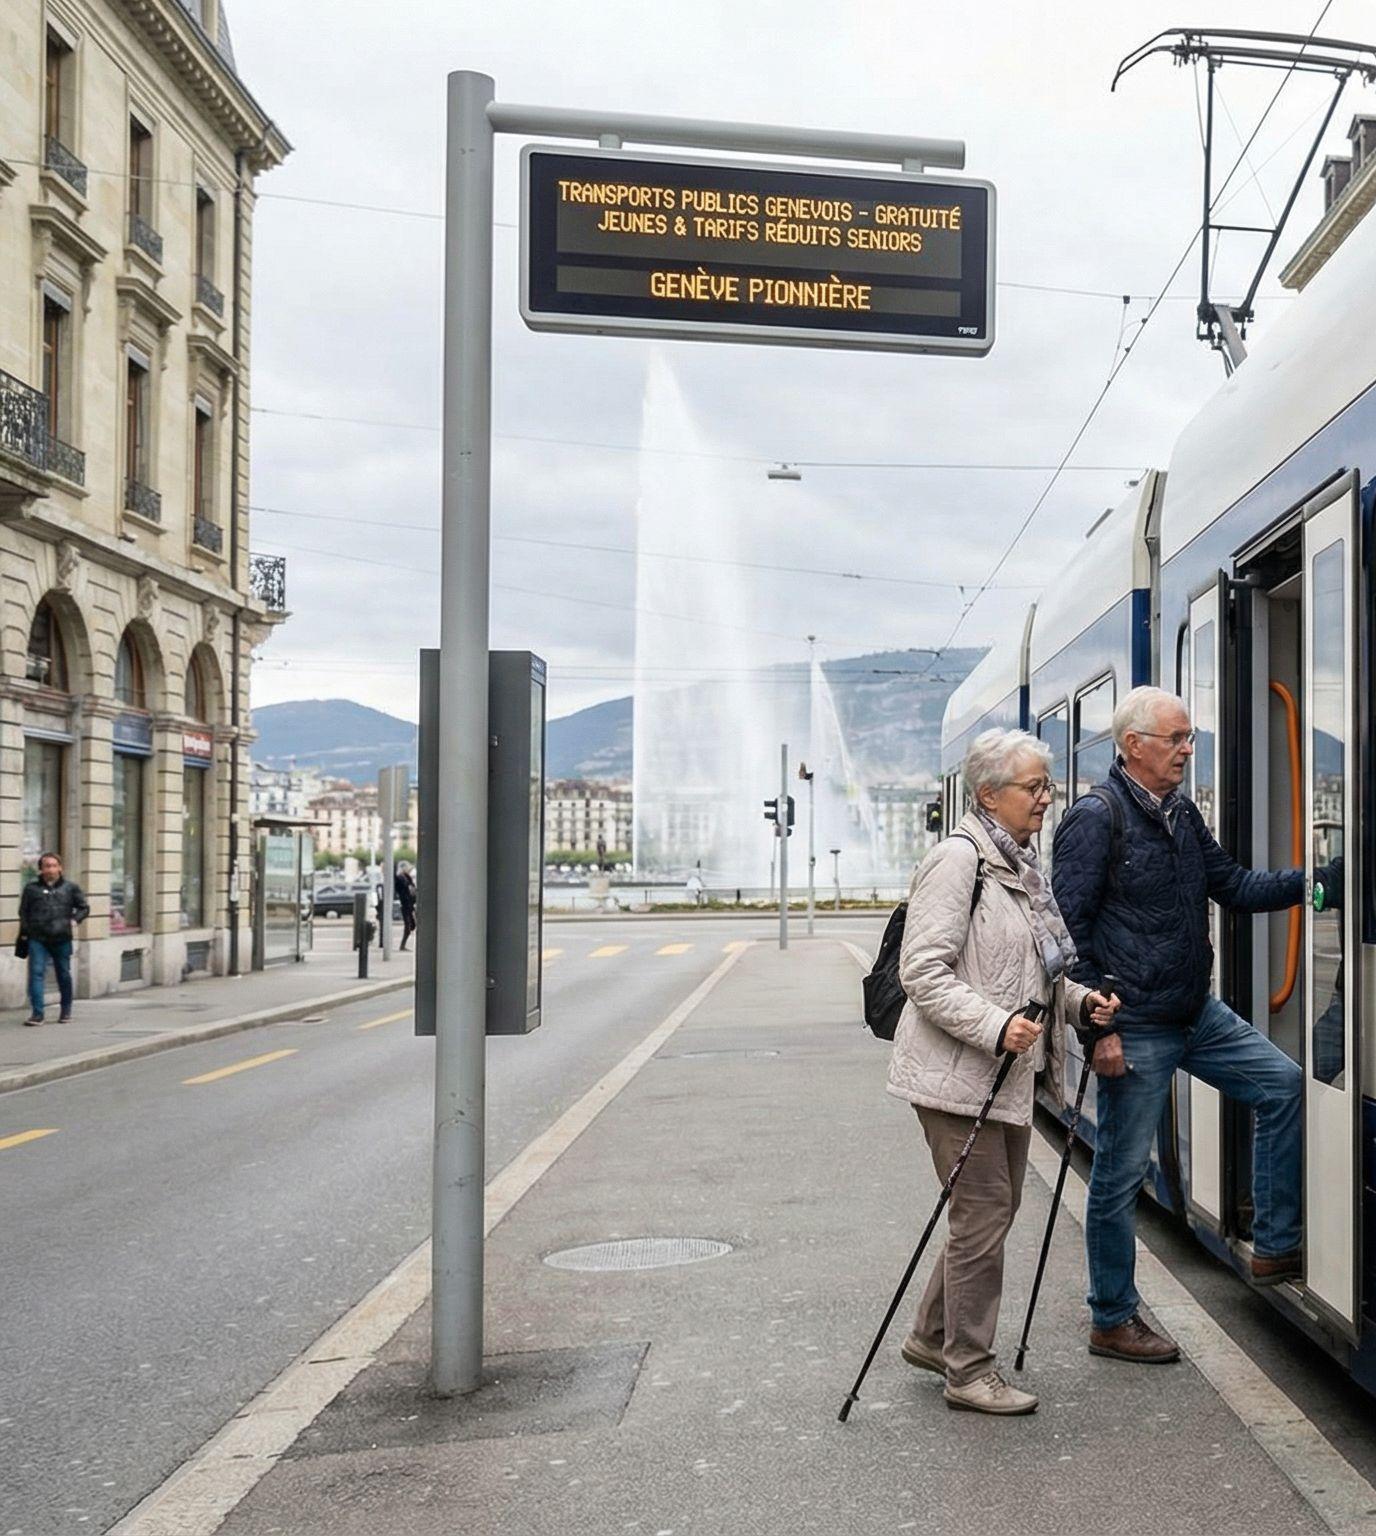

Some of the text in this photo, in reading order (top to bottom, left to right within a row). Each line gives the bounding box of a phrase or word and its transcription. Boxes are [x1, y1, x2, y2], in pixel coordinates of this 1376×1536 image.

[559, 180, 676, 210] TRANSPORTS
[681, 189, 759, 216] PUBLICS
[765, 197, 853, 222] GENEVOIS
[875, 205, 961, 230] GRATUITÉ
[598, 210, 922, 252] JEUNES & TARIFS RÉDUITS SENIORS
[650, 267, 872, 310] GENÈVE PIONNIÈRE
